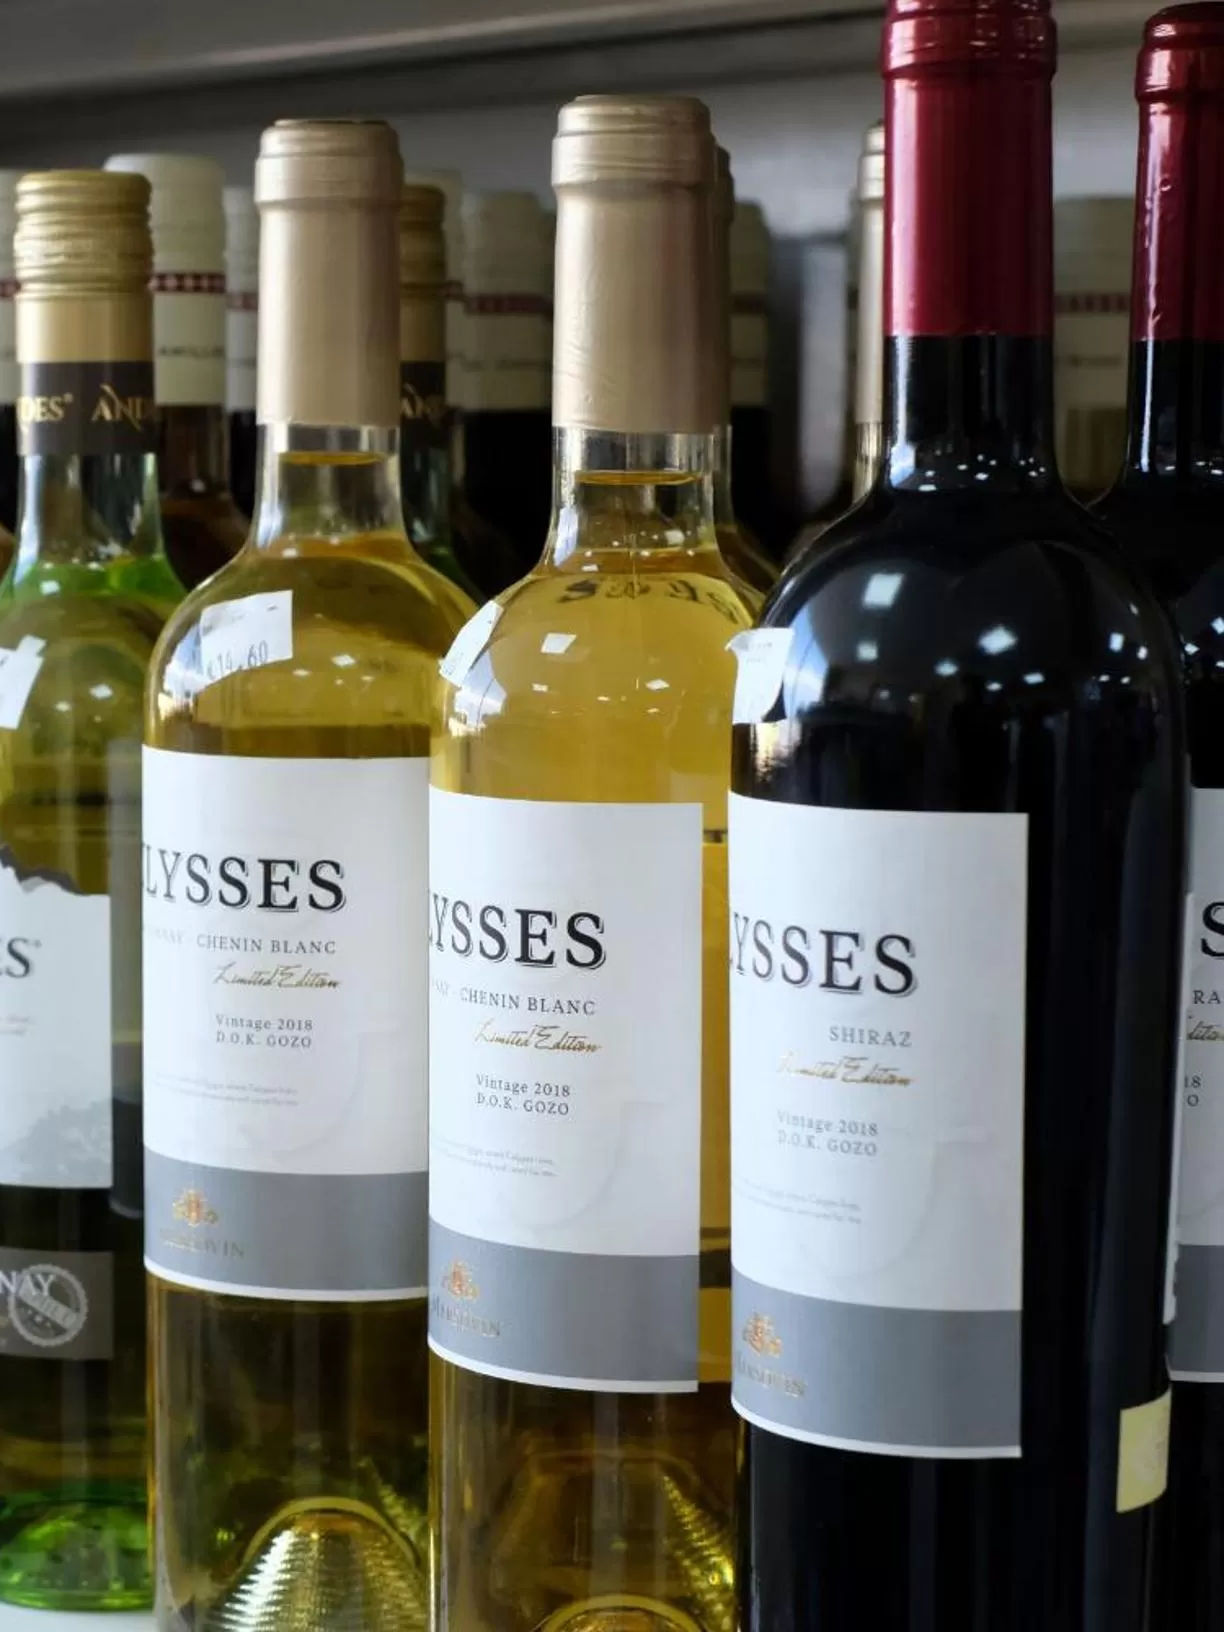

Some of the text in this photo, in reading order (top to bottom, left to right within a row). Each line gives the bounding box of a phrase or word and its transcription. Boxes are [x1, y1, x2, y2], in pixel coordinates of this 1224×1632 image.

[143, 843, 347, 913] LYSSES
[428, 892, 607, 970] YSSES
[196, 933, 263, 953] CHENIN
[271, 938, 337, 955] BLANC
[729, 911, 918, 998] YSSES
[460, 984, 520, 1010] CHENIN
[527, 996, 596, 1015] BLANC
[215, 1012, 313, 1032] Vintage 2018
[216, 1031, 312, 1049] D.O.K. GOZO
[829, 1025, 913, 1048] SHIRAZ
[476, 1073, 571, 1098] Vintage 2018
[476, 1092, 569, 1116] D.O.K. GOZO
[778, 1109, 879, 1137] Vintage 2018
[827, 1138, 877, 1156] GOZO
